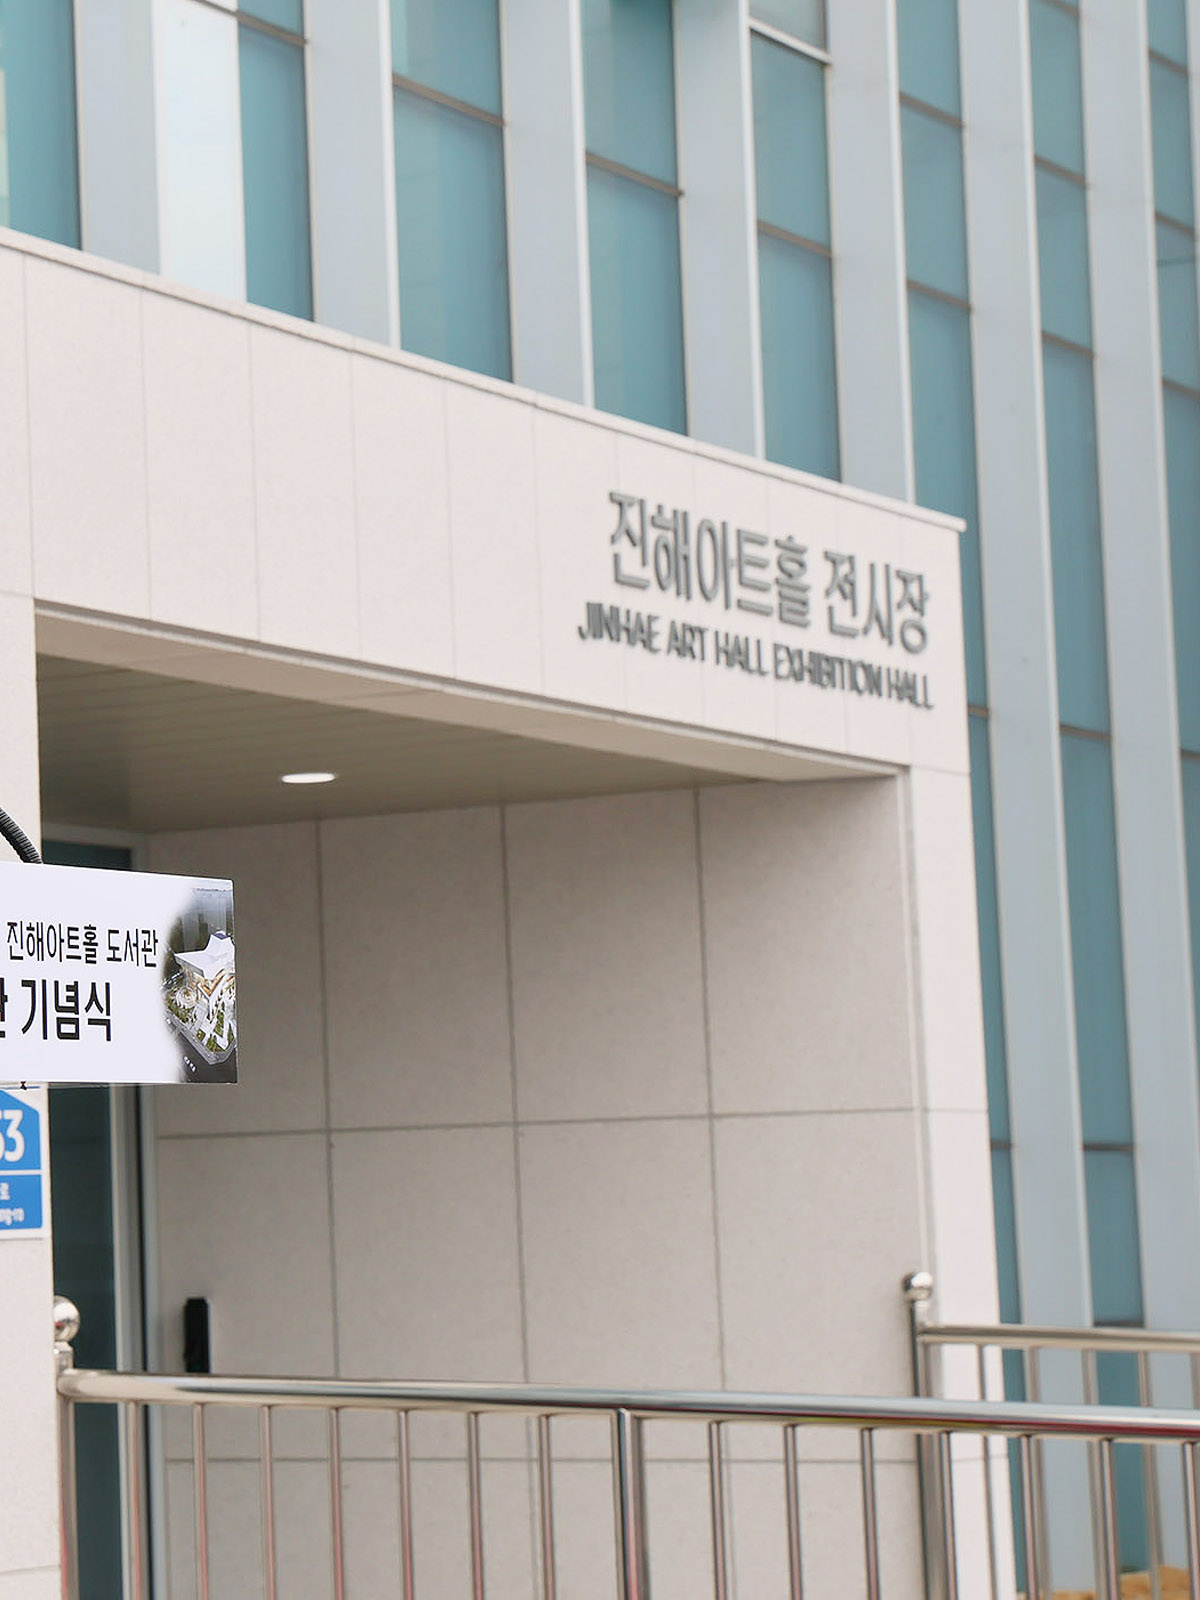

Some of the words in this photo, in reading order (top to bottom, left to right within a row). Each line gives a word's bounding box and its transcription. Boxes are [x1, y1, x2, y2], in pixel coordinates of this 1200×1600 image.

[609, 491, 811, 629] 진해아트홀
[823, 549, 929, 655] 전시장
[578, 601, 661, 655] JINHAE
[667, 618, 709, 662] ART
[715, 629, 770, 677] HALL
[773, 642, 883, 699] EXHIBITION
[887, 665, 934, 710] HALL
[6, 920, 100, 965] 진해아트홀
[105, 928, 159, 968] 도서관
[21, 979, 113, 1043] 기념식
